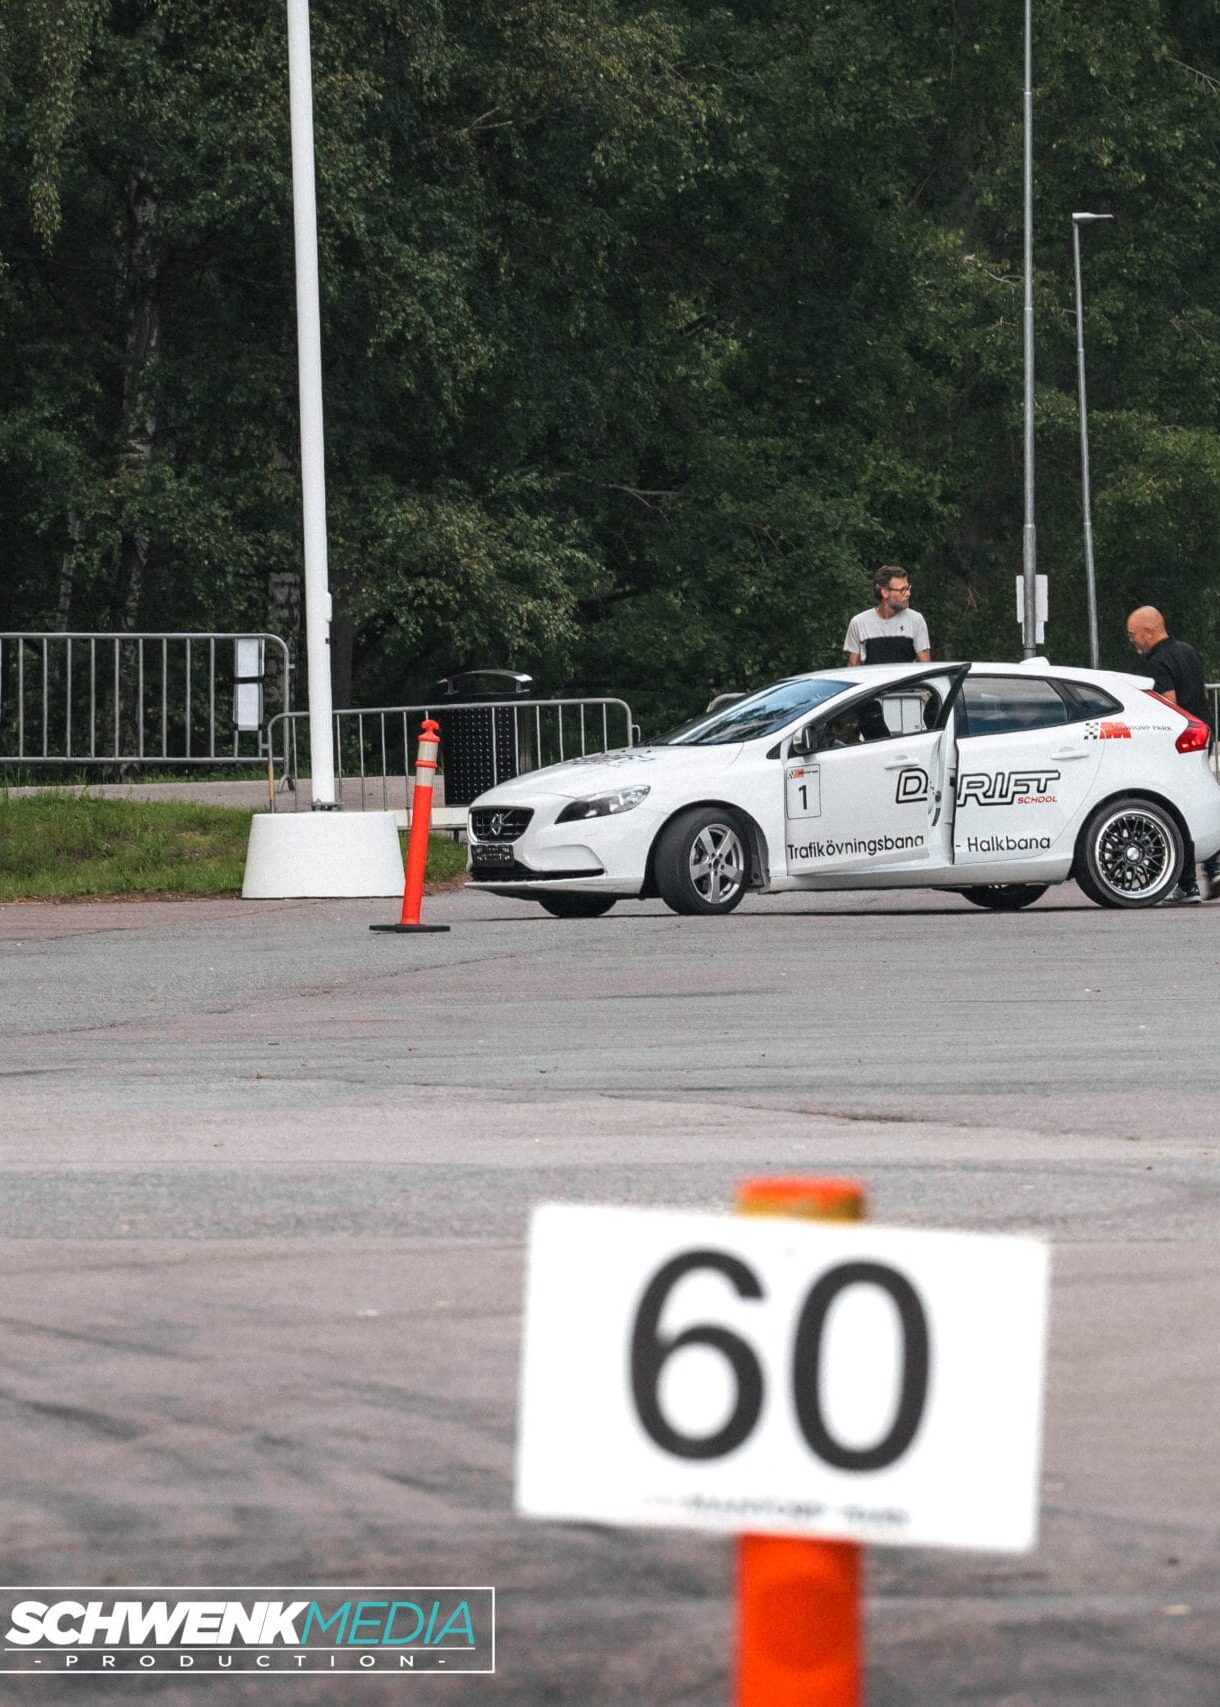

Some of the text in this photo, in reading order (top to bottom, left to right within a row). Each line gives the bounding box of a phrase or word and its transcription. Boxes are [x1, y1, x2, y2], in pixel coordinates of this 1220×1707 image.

[798, 784, 807, 810] 1
[1017, 795, 1058, 804] SCHOOL
[787, 835, 924, 859] Trafikövningsbana
[967, 836, 1050, 851] Halkbana
[628, 1247, 932, 1472] 60
